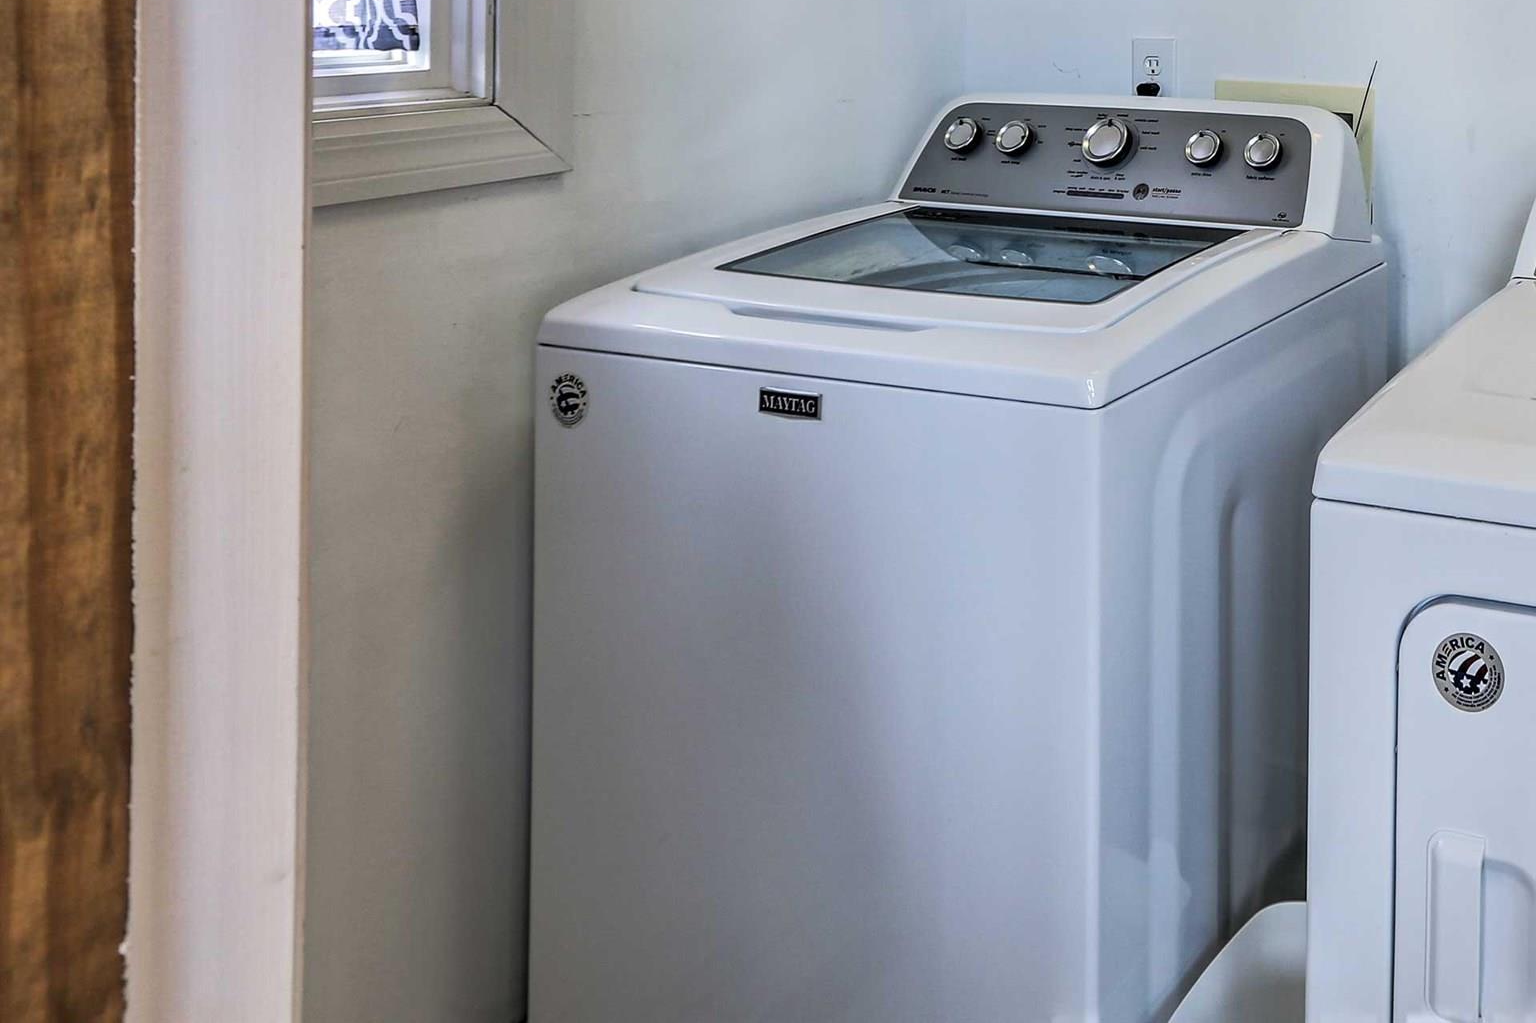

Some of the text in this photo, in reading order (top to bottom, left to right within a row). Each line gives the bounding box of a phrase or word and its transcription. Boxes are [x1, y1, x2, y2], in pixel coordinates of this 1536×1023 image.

[551, 373, 588, 398] AMERICA
[762, 394, 816, 414] MAYTAG
[1436, 636, 1485, 681] AMERICA
